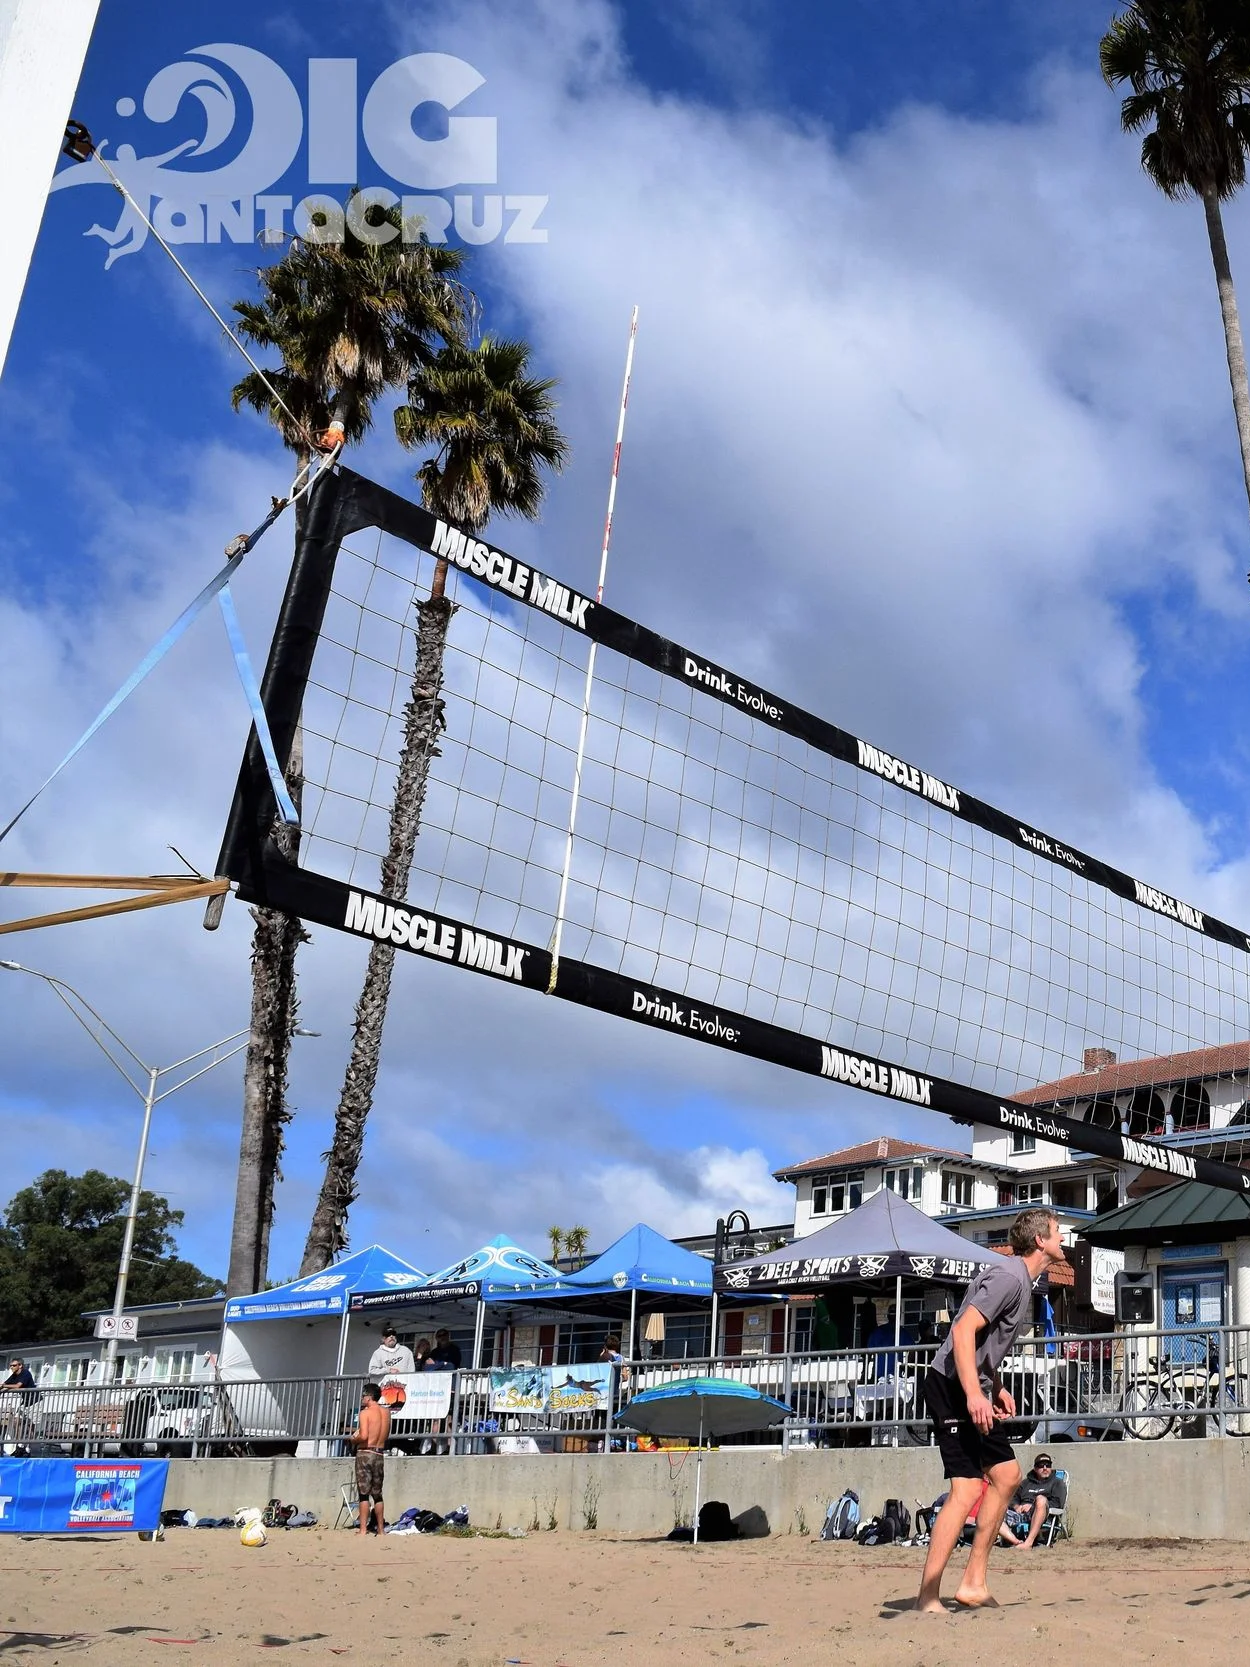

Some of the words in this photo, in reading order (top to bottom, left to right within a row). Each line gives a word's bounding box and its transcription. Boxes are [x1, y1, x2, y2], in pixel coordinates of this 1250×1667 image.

[430, 519, 529, 598] MUSCLE
[529, 571, 593, 630] MILK
[684, 657, 736, 698] Drink.
[856, 739, 921, 792] MUSCLE
[921, 771, 960, 812] MILK
[1019, 827, 1055, 857] Drink.
[1133, 880, 1178, 918] MUSCLE
[1176, 901, 1205, 932] MILK
[343, 890, 457, 960] MUSCLE
[457, 927, 527, 981] MILK
[631, 991, 687, 1027] Drink.
[820, 1045, 889, 1094] MUSCLE
[889, 1067, 934, 1106] MILK
[999, 1106, 1036, 1131] Drink.
[1120, 1136, 1168, 1170] MUSCLE
[1167, 1148, 1198, 1179] MILK
[757, 1260, 800, 1281] 2DEEP
[802, 1256, 853, 1277] SPORTS
[941, 1258, 975, 1277] 2DEEP
[75, 1470, 117, 1479] CALIFORNIA
[118, 1470, 141, 1479] BEACH
